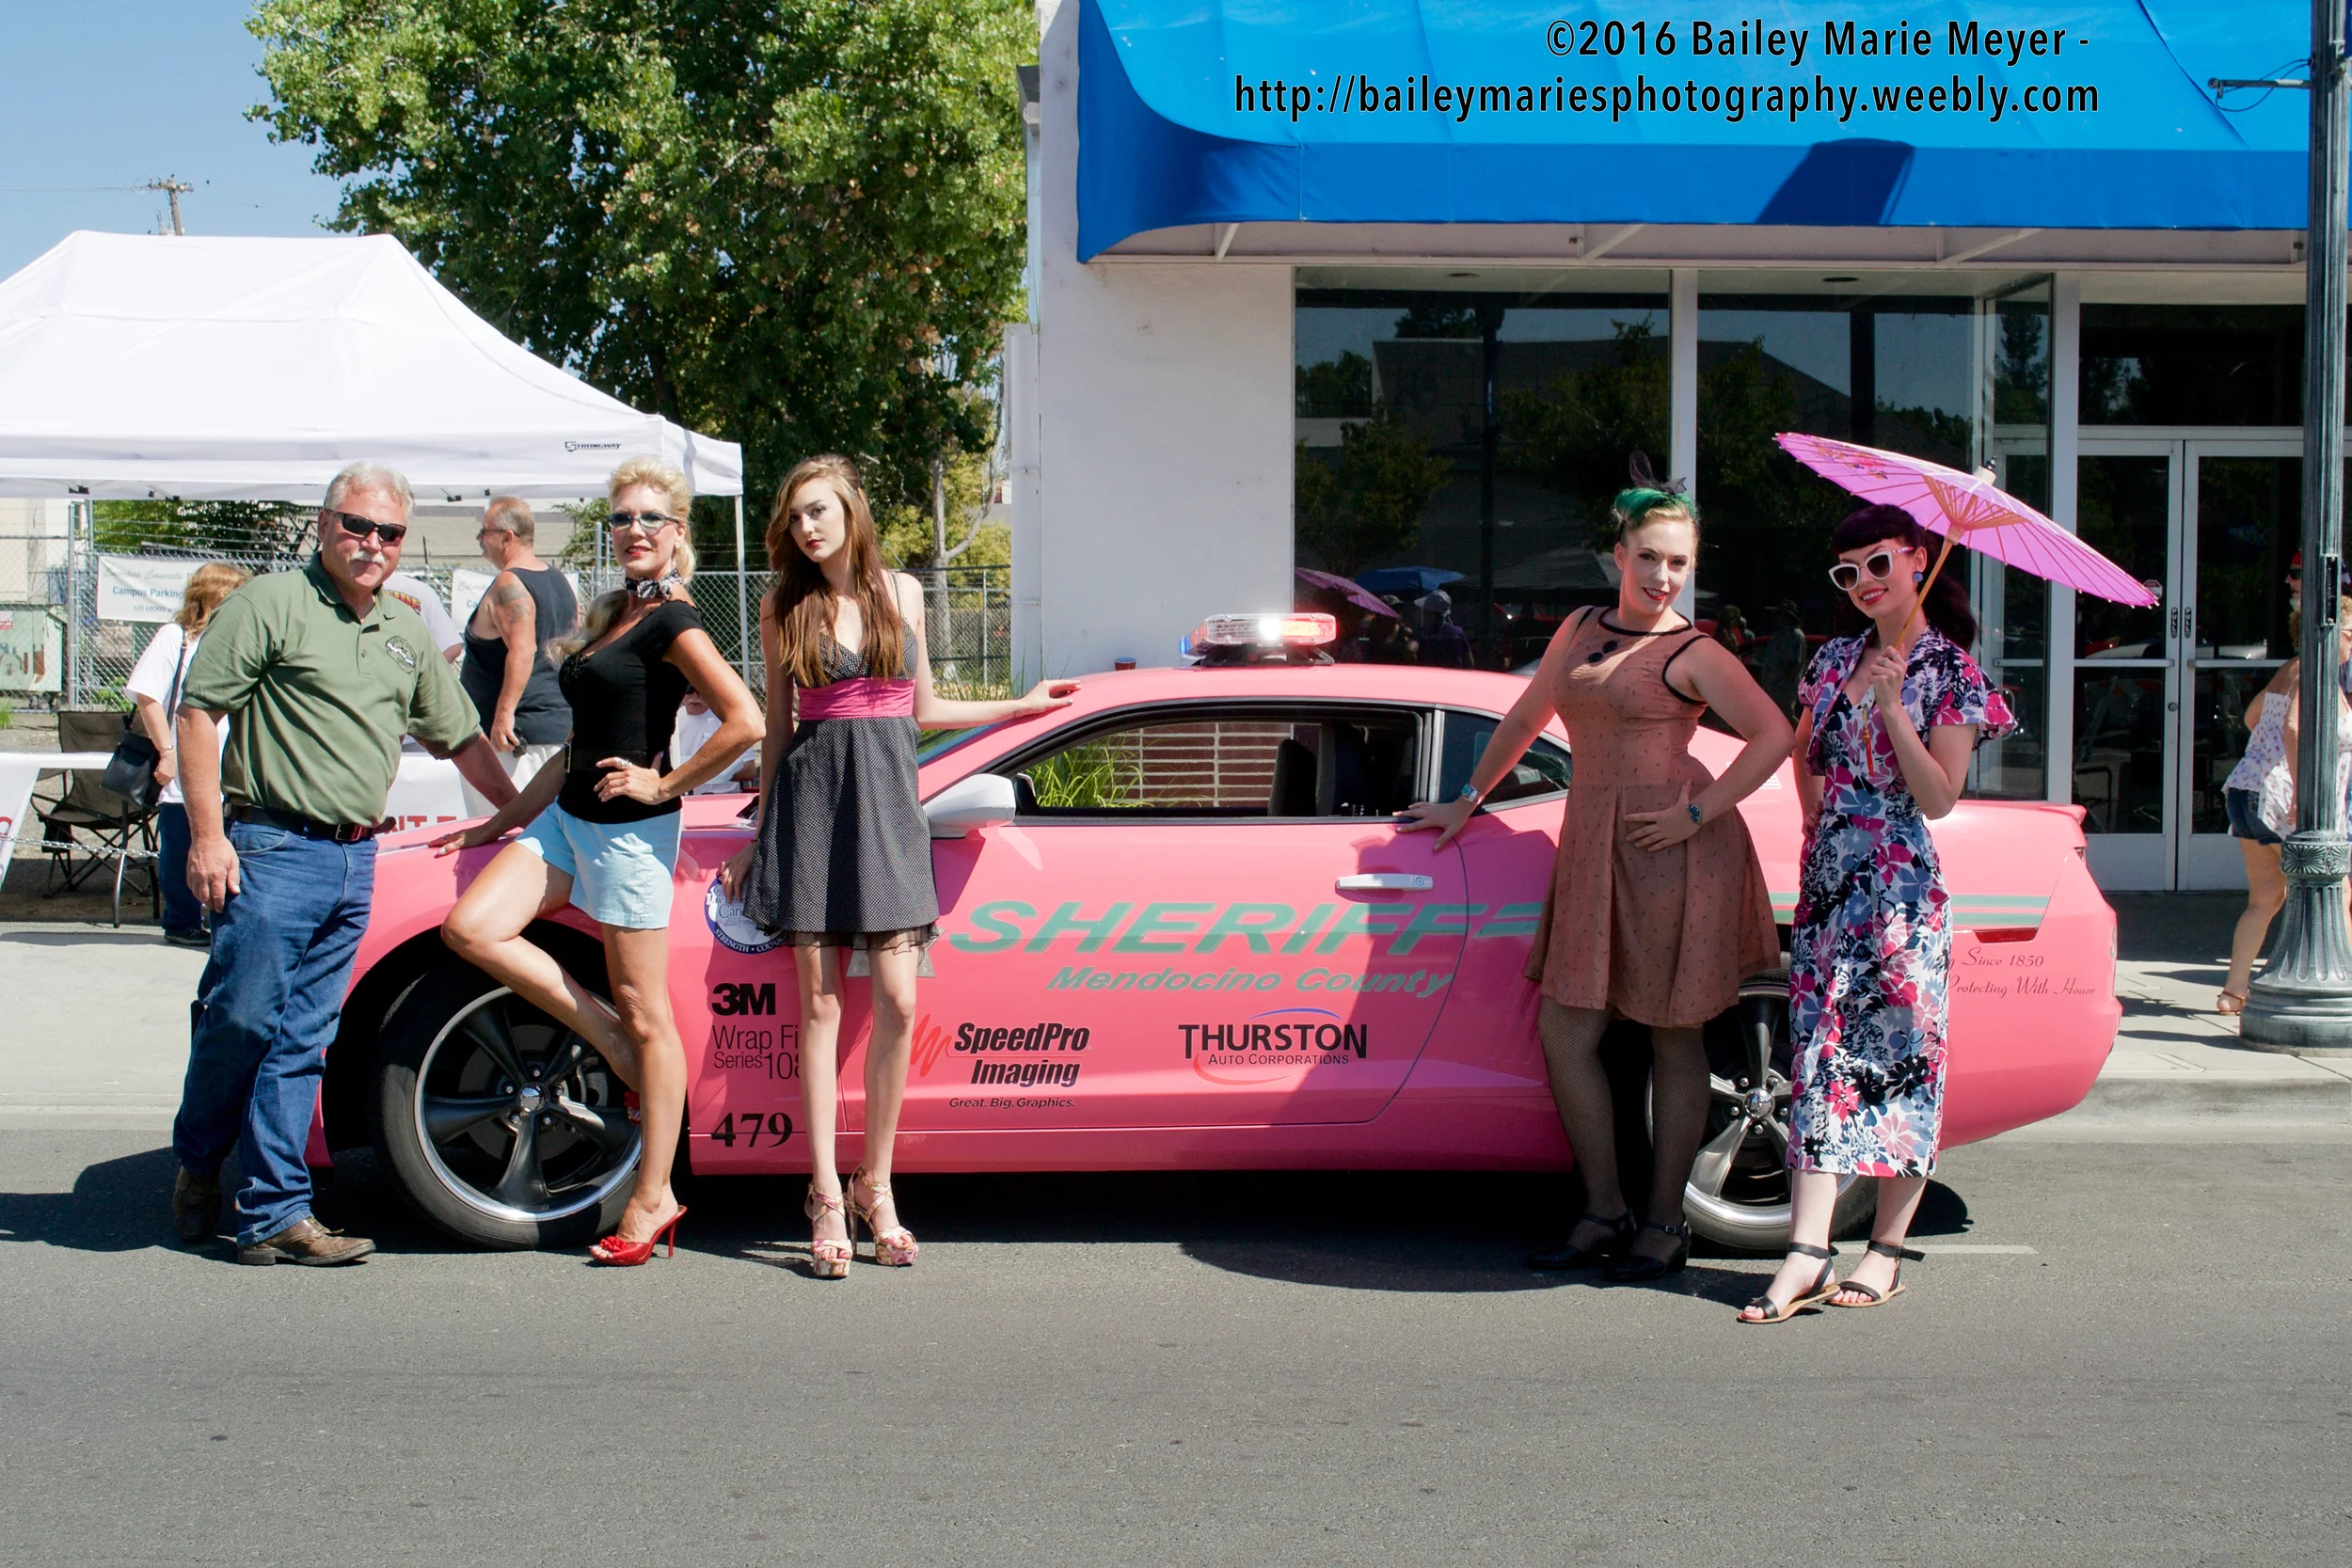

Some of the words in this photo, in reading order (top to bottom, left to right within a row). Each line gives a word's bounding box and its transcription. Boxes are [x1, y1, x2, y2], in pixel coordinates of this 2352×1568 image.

[112, 586, 148, 598] Campos
[150, 588, 183, 599] Parking
[714, 928, 749, 953] STRENGTH
[948, 900, 1489, 956] SHERIFF
[1962, 947, 2002, 967] Since
[2010, 955, 2044, 968] 1850
[1045, 967, 1281, 991] Mendocino
[1295, 967, 1454, 998] County
[2016, 975, 2048, 995] With
[2054, 976, 2096, 995] Honor
[711, 983, 776, 1016] 3M
[712, 1024, 772, 1054] Wrap
[954, 1022, 1090, 1054] SpeedPro
[1178, 1023, 1368, 1059] THURSTON
[713, 1051, 763, 1069] Series
[971, 1059, 1081, 1088] Imaging
[949, 1098, 988, 1108] Great.
[990, 1098, 1015, 1110] Big.
[1016, 1097, 1075, 1110] Graphics.
[710, 1112, 793, 1148] 479
